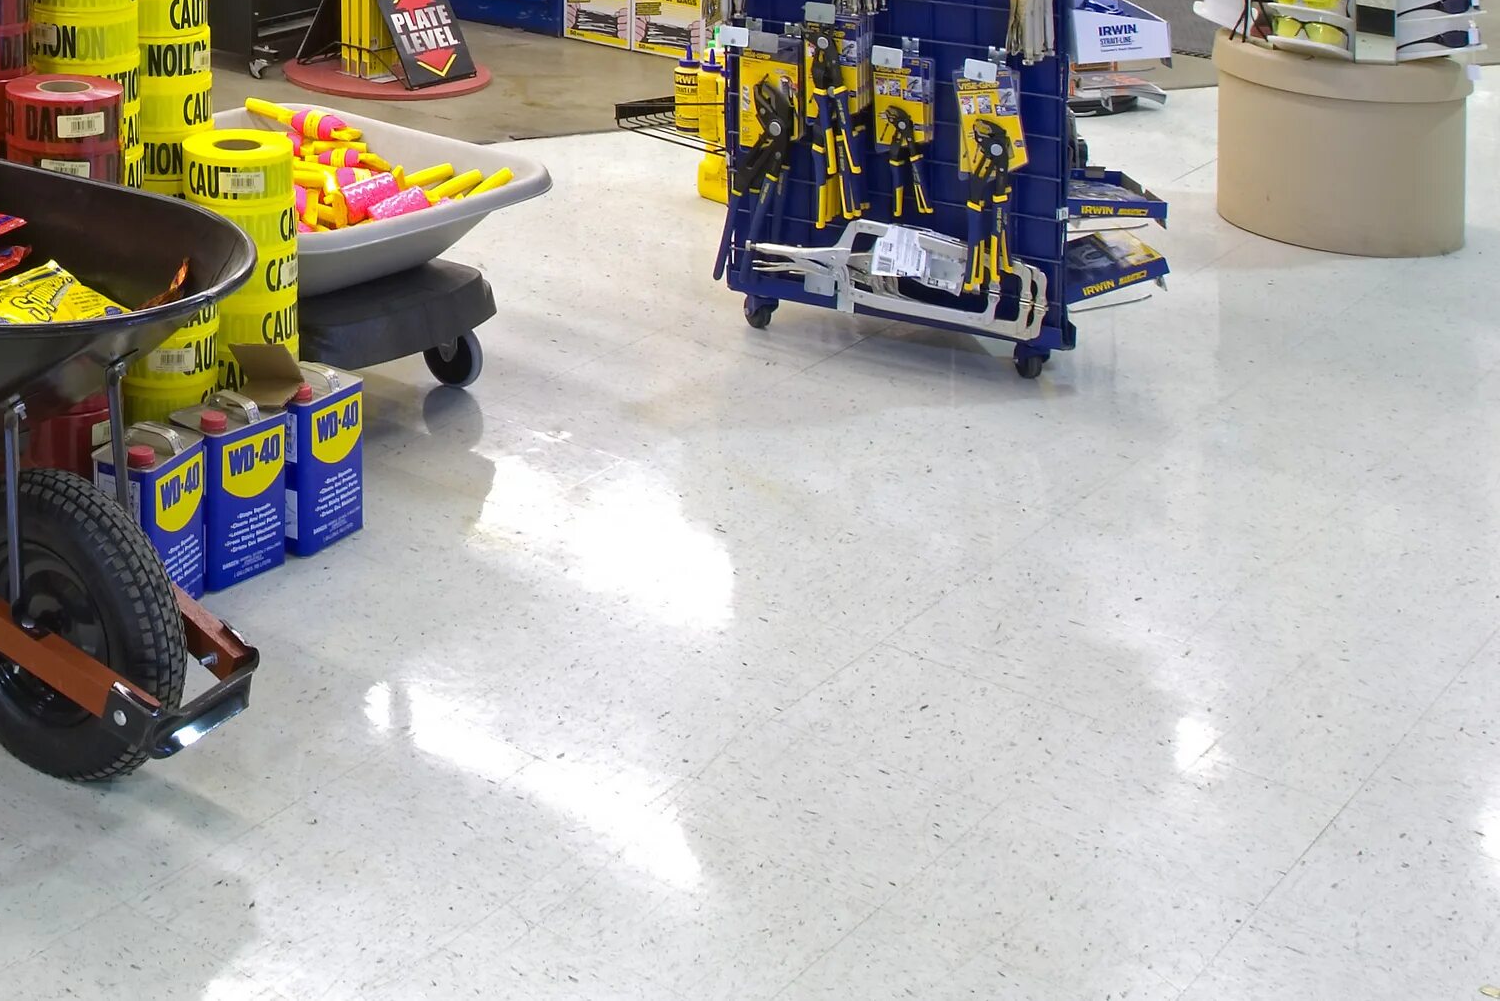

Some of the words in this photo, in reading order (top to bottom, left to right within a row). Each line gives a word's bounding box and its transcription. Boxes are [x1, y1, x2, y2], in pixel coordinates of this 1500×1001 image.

[390, 4, 451, 33] PLATE
[1098, 24, 1138, 37] IRWIN
[400, 27, 459, 55] LEVEL
[1081, 205, 1114, 215] IRWIN
[1082, 279, 1116, 297] IRWIN
[316, 400, 360, 444] WD-40
[228, 433, 282, 477] WD-40
[160, 460, 201, 512] WD-40
